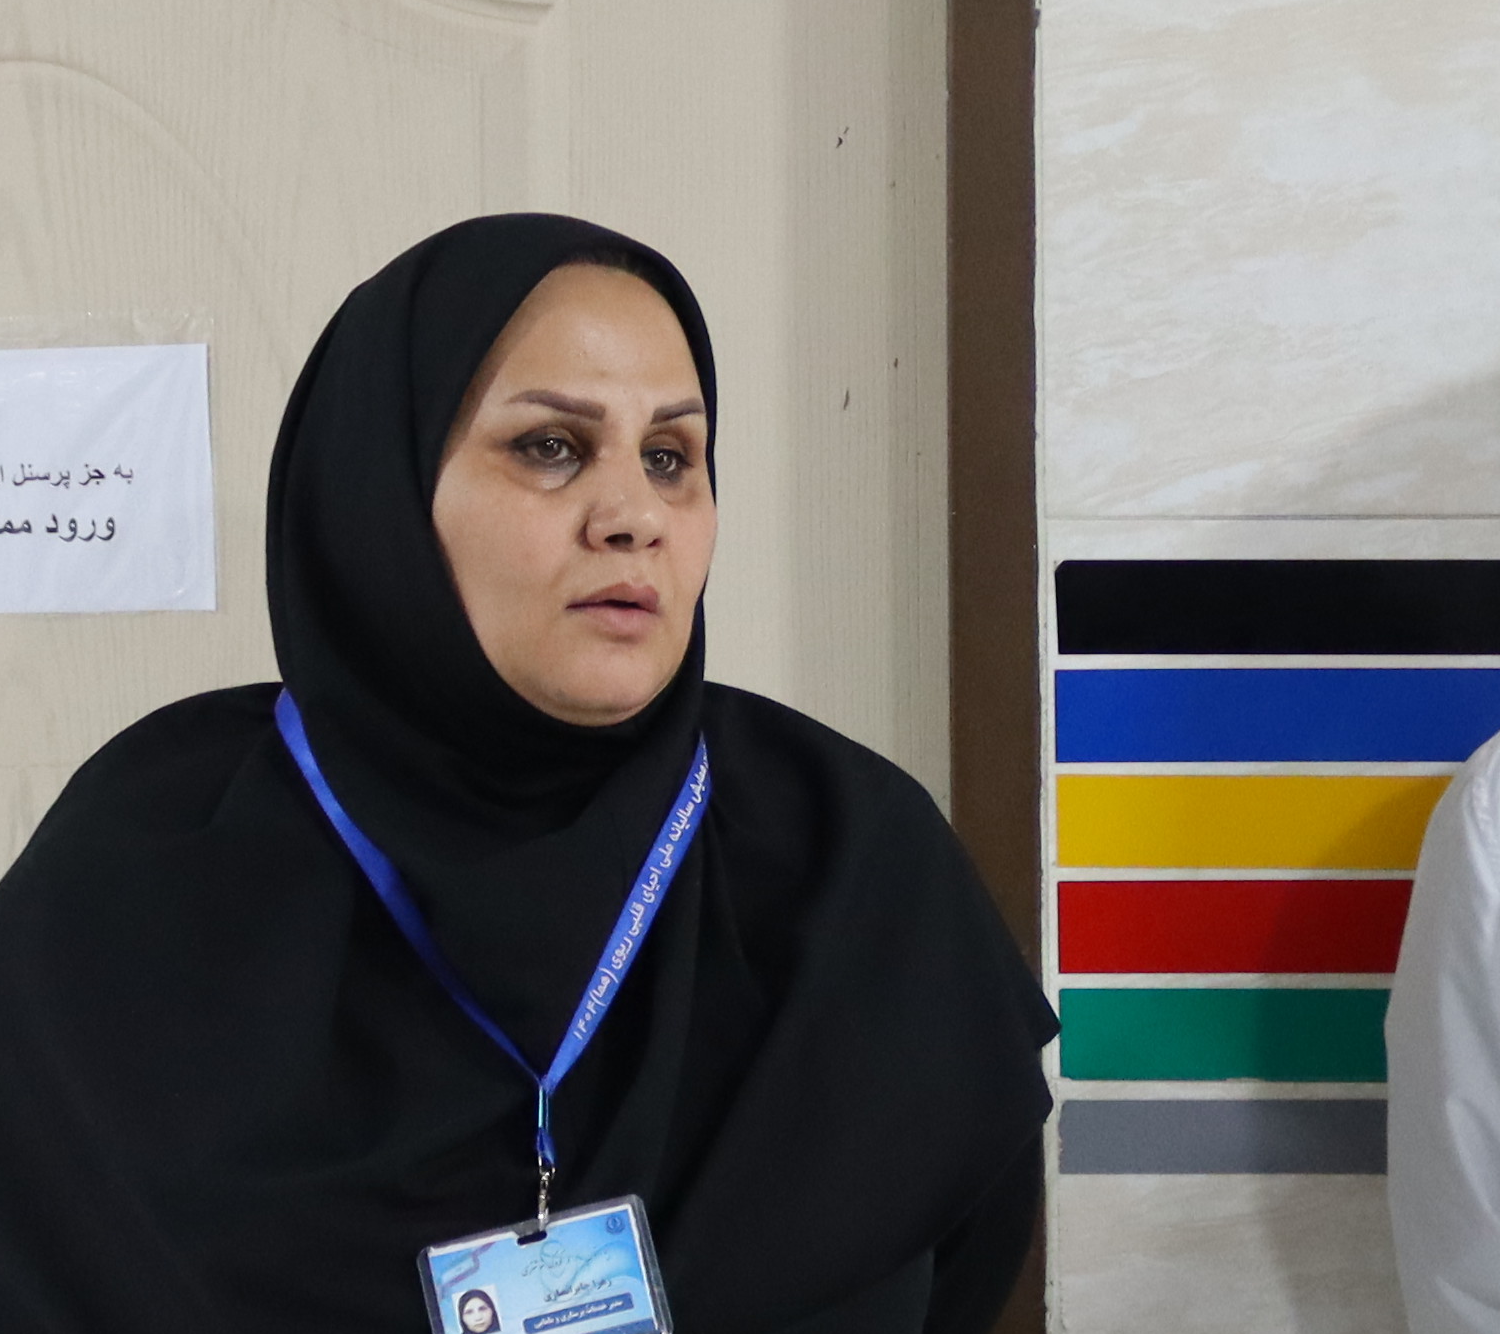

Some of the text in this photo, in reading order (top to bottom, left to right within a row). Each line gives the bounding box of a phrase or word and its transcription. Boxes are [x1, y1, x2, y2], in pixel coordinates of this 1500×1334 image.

[12, 463, 71, 489] پرسنل
[78, 463, 106, 489] جز
[112, 463, 134, 485] به
[46, 512, 116, 542] ورود
[668, 801, 695, 842] سالیانه
[658, 843, 675, 868] ملی
[642, 866, 663, 904] احیای
[629, 901, 646, 937] قلبی
[611, 936, 634, 970] ریوی
